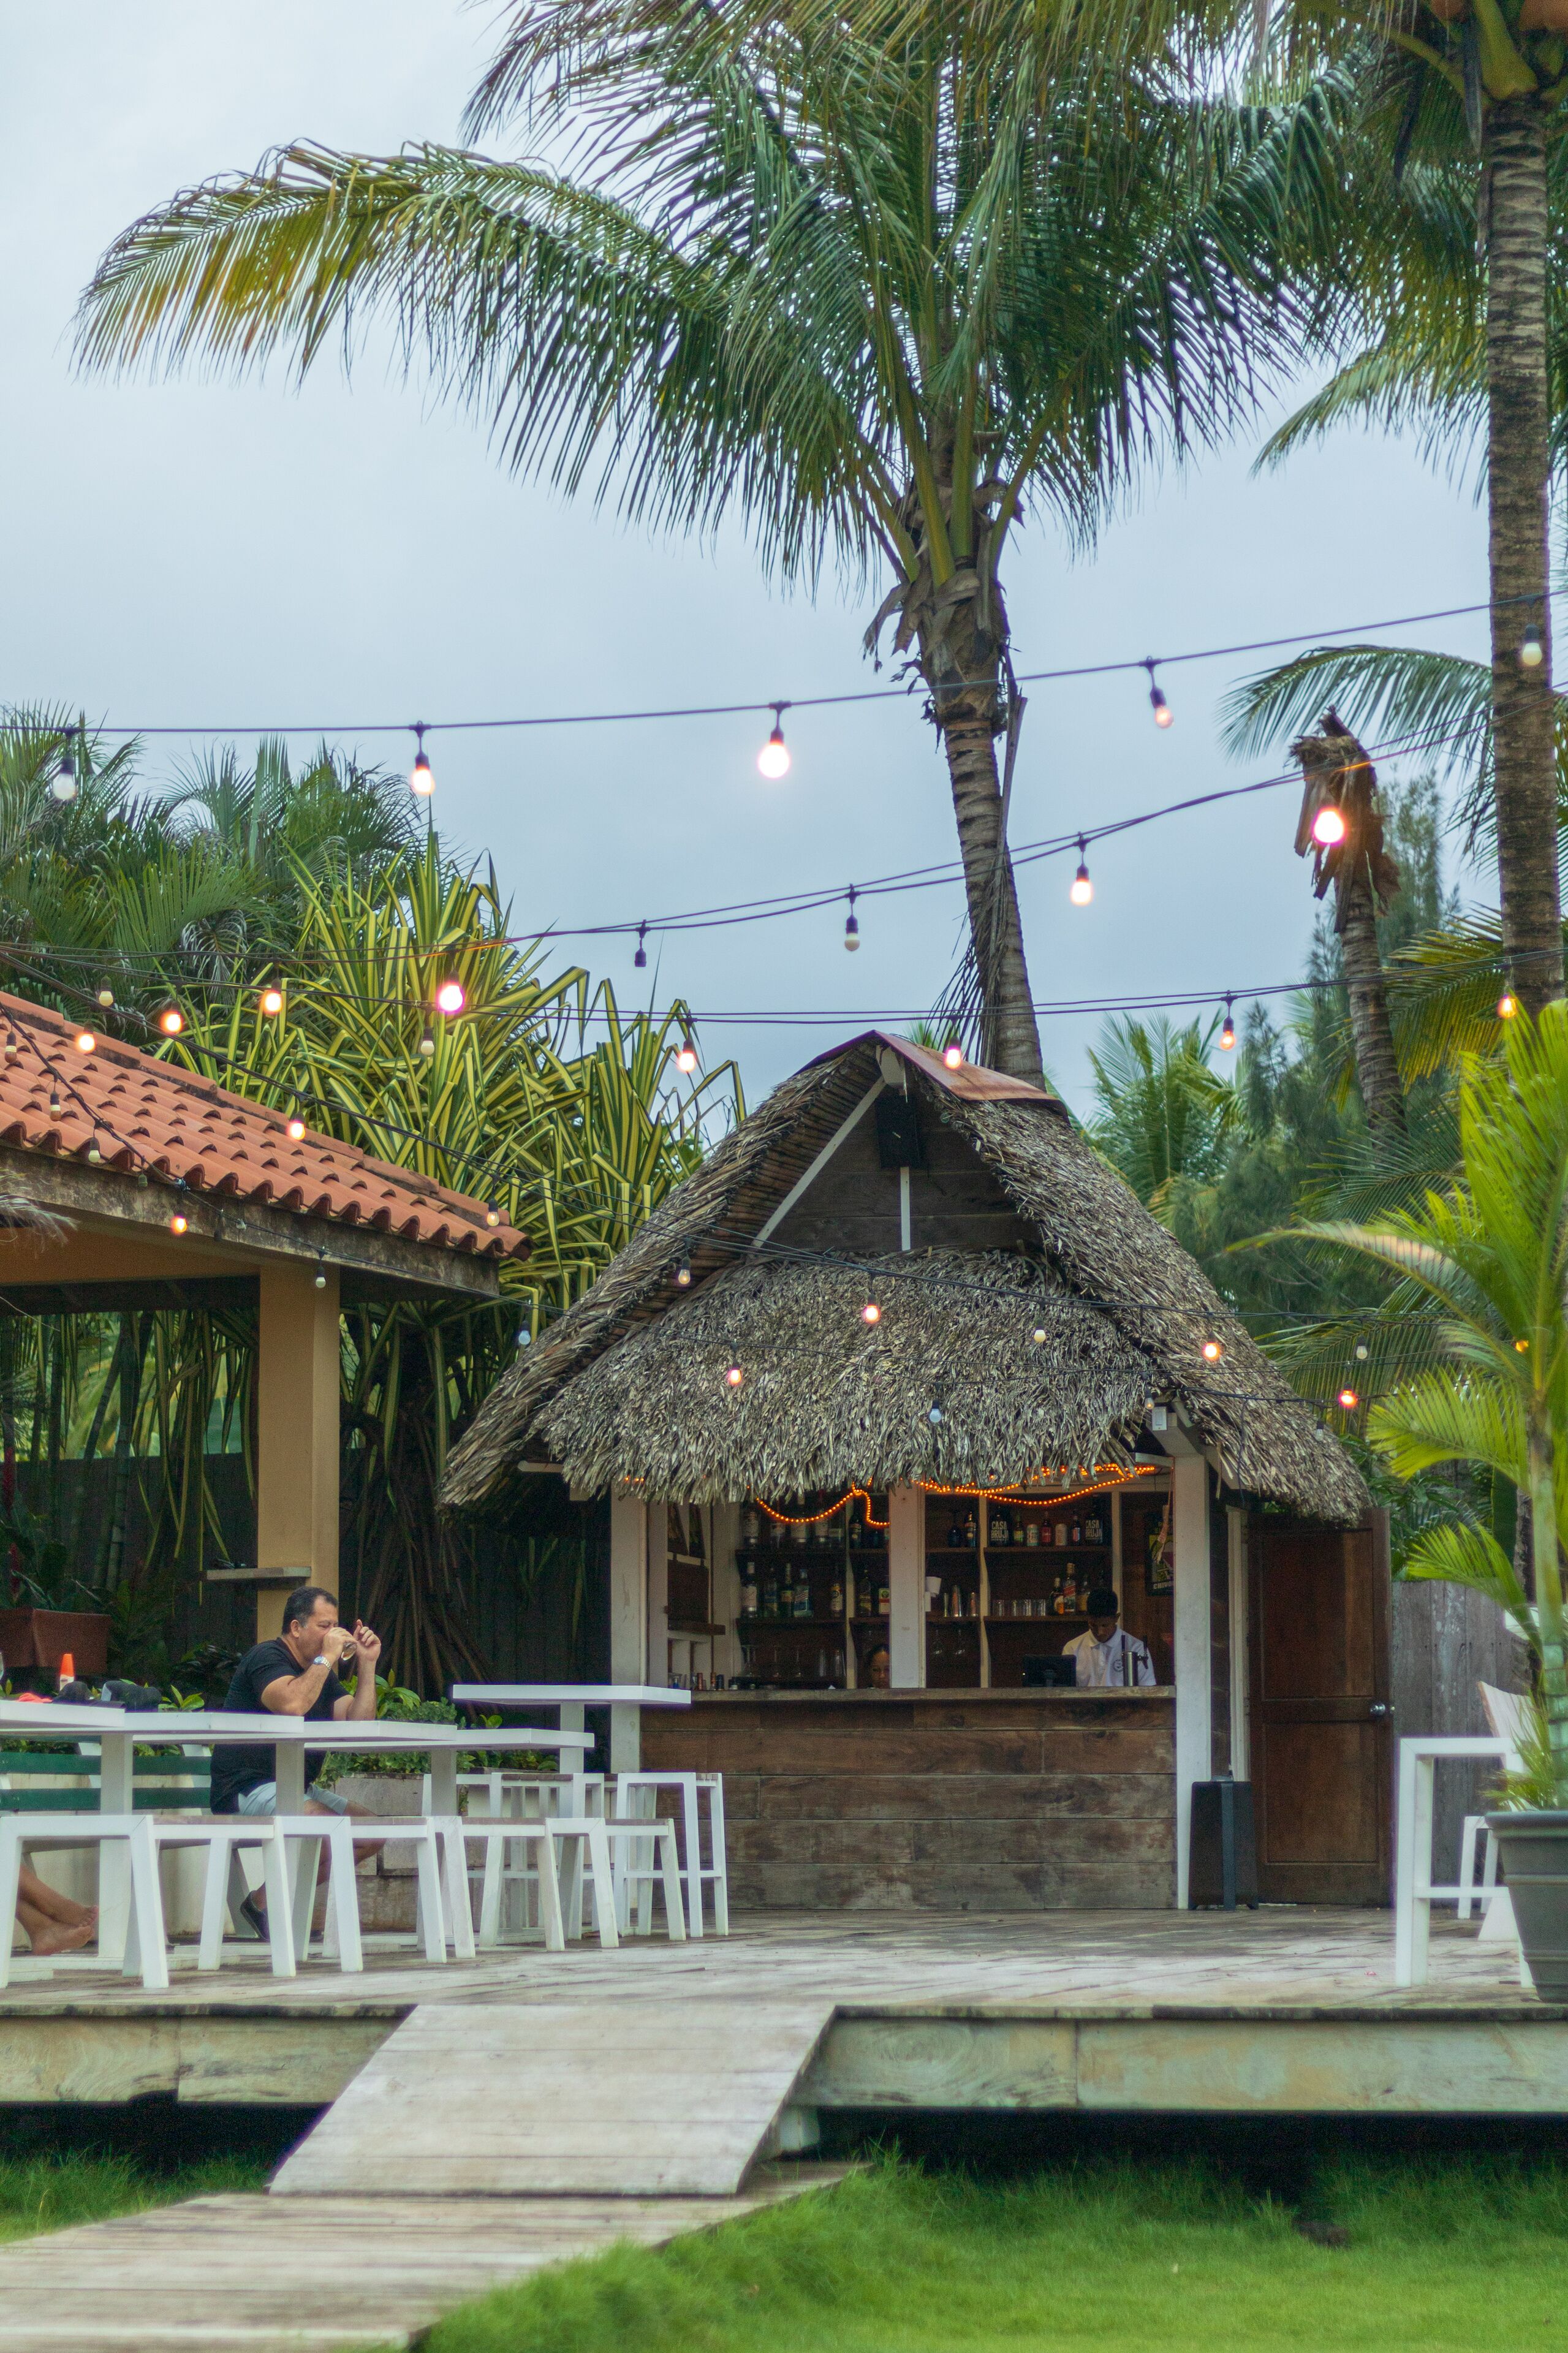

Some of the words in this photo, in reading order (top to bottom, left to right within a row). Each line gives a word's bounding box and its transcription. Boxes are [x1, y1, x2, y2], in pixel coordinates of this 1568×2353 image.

[991, 1521, 1007, 1529] CASA
[1086, 1520, 1100, 1528] CASA
[991, 1530, 1009, 1539] BRUJA
